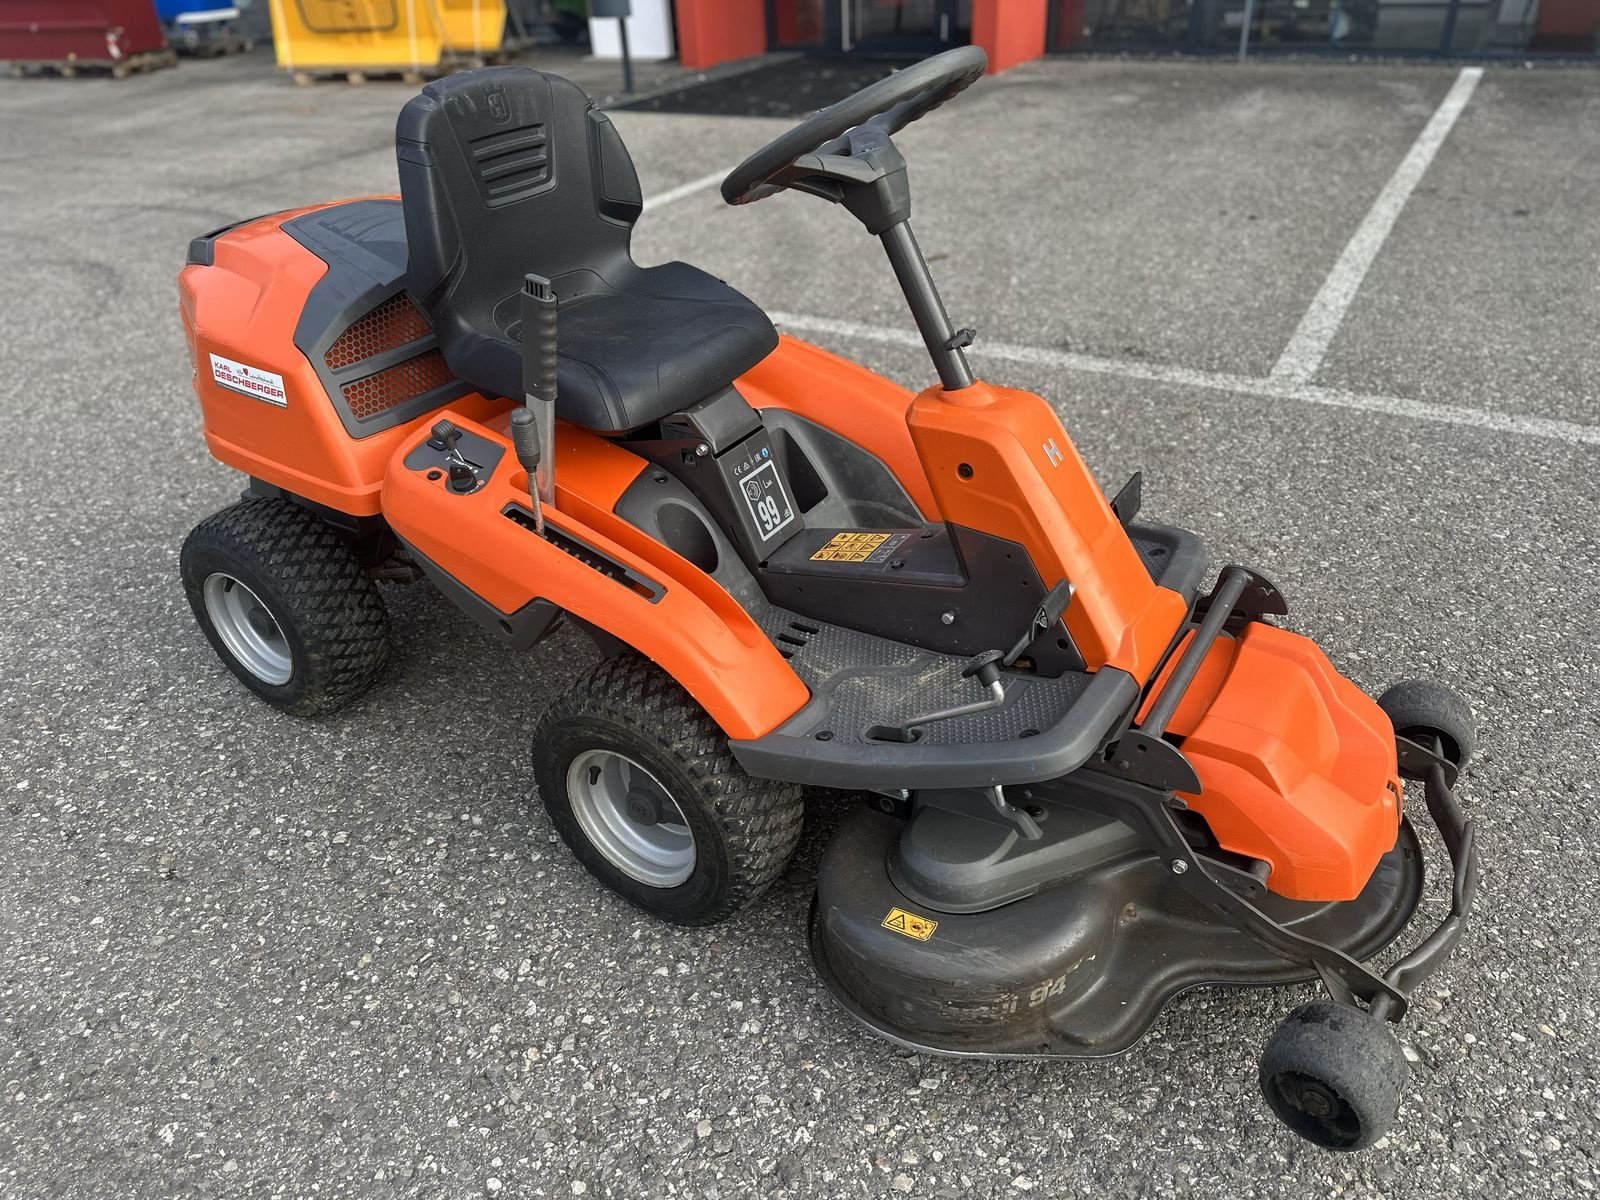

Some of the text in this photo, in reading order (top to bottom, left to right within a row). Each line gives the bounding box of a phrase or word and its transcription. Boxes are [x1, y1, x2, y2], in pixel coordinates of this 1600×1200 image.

[214, 362, 232, 373] KARL
[214, 369, 284, 399] DESCHBERGER
[757, 495, 781, 531] 99
[1028, 974, 1066, 1008] 94
